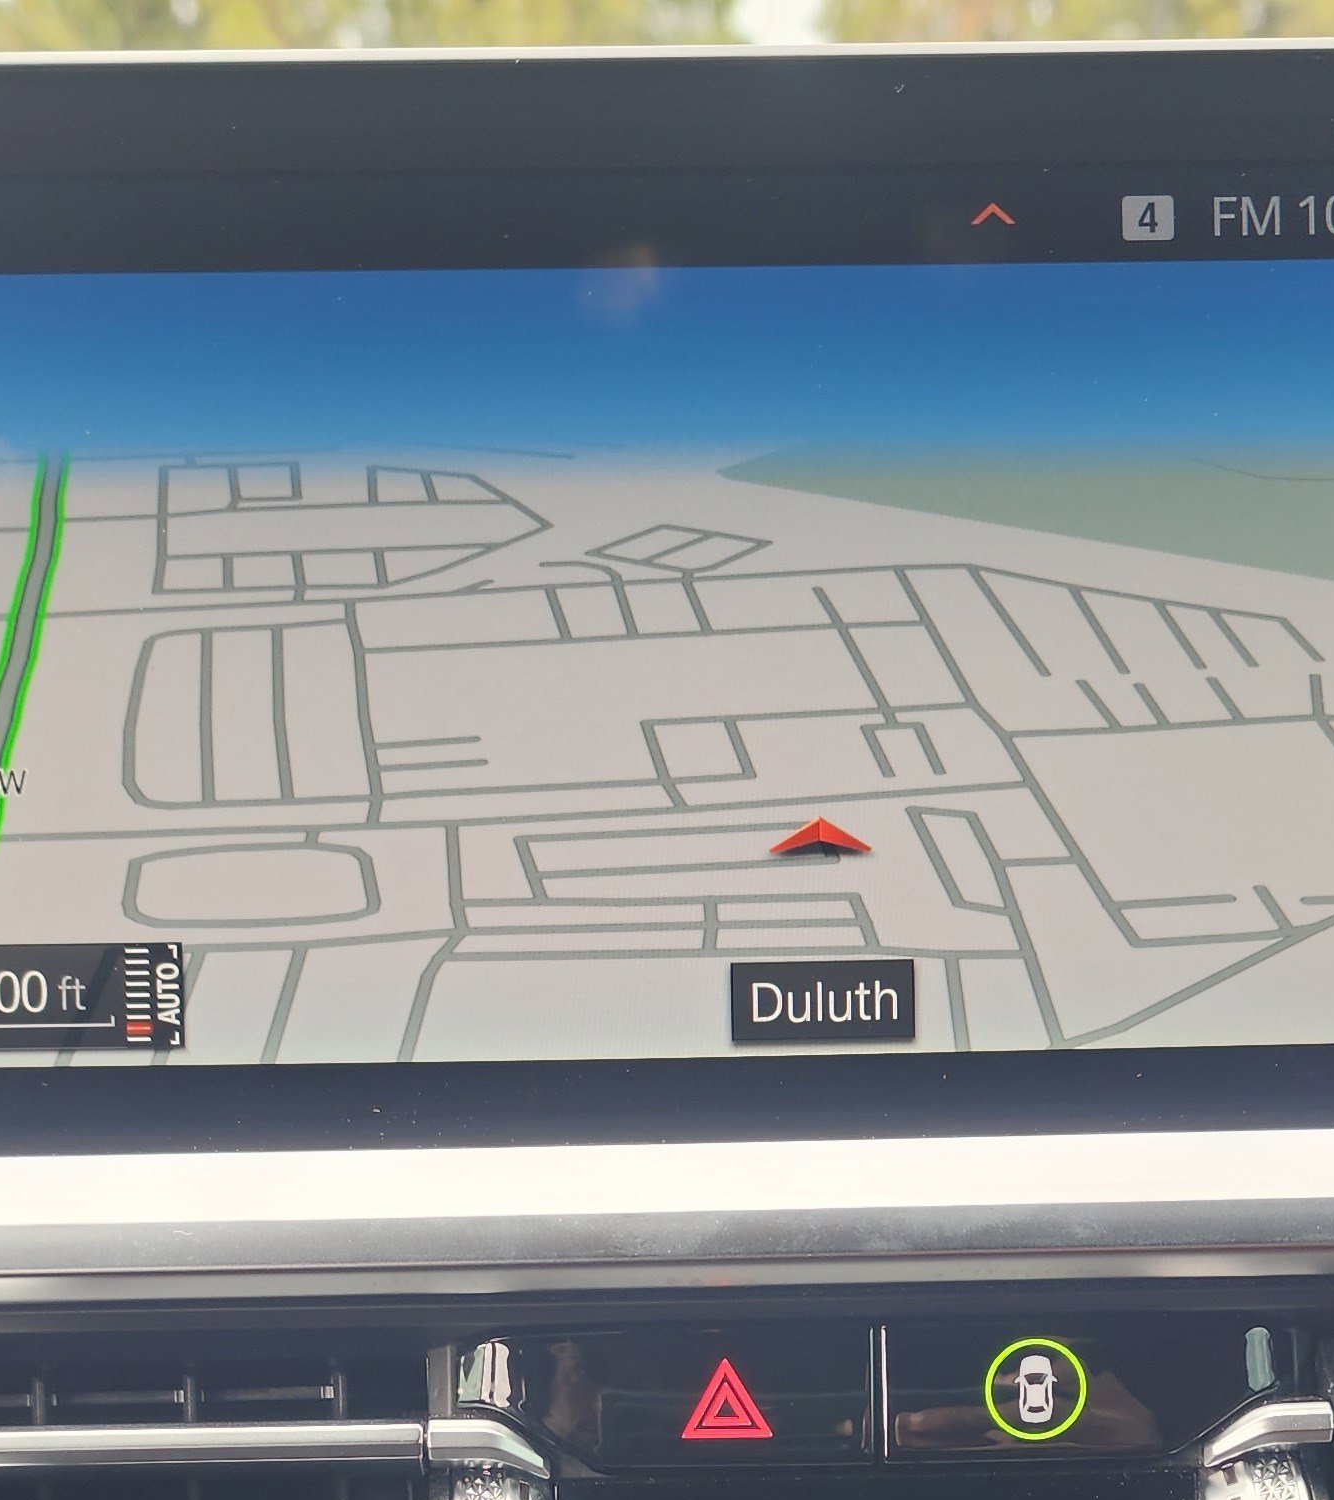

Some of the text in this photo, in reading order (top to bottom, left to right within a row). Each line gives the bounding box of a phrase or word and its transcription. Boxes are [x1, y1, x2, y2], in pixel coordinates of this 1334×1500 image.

[1138, 201, 1159, 233] 4
[1213, 195, 1281, 236] FM
[57, 975, 87, 1011] ft
[155, 962, 181, 1026] AUTO
[752, 980, 898, 1024] Duluth
